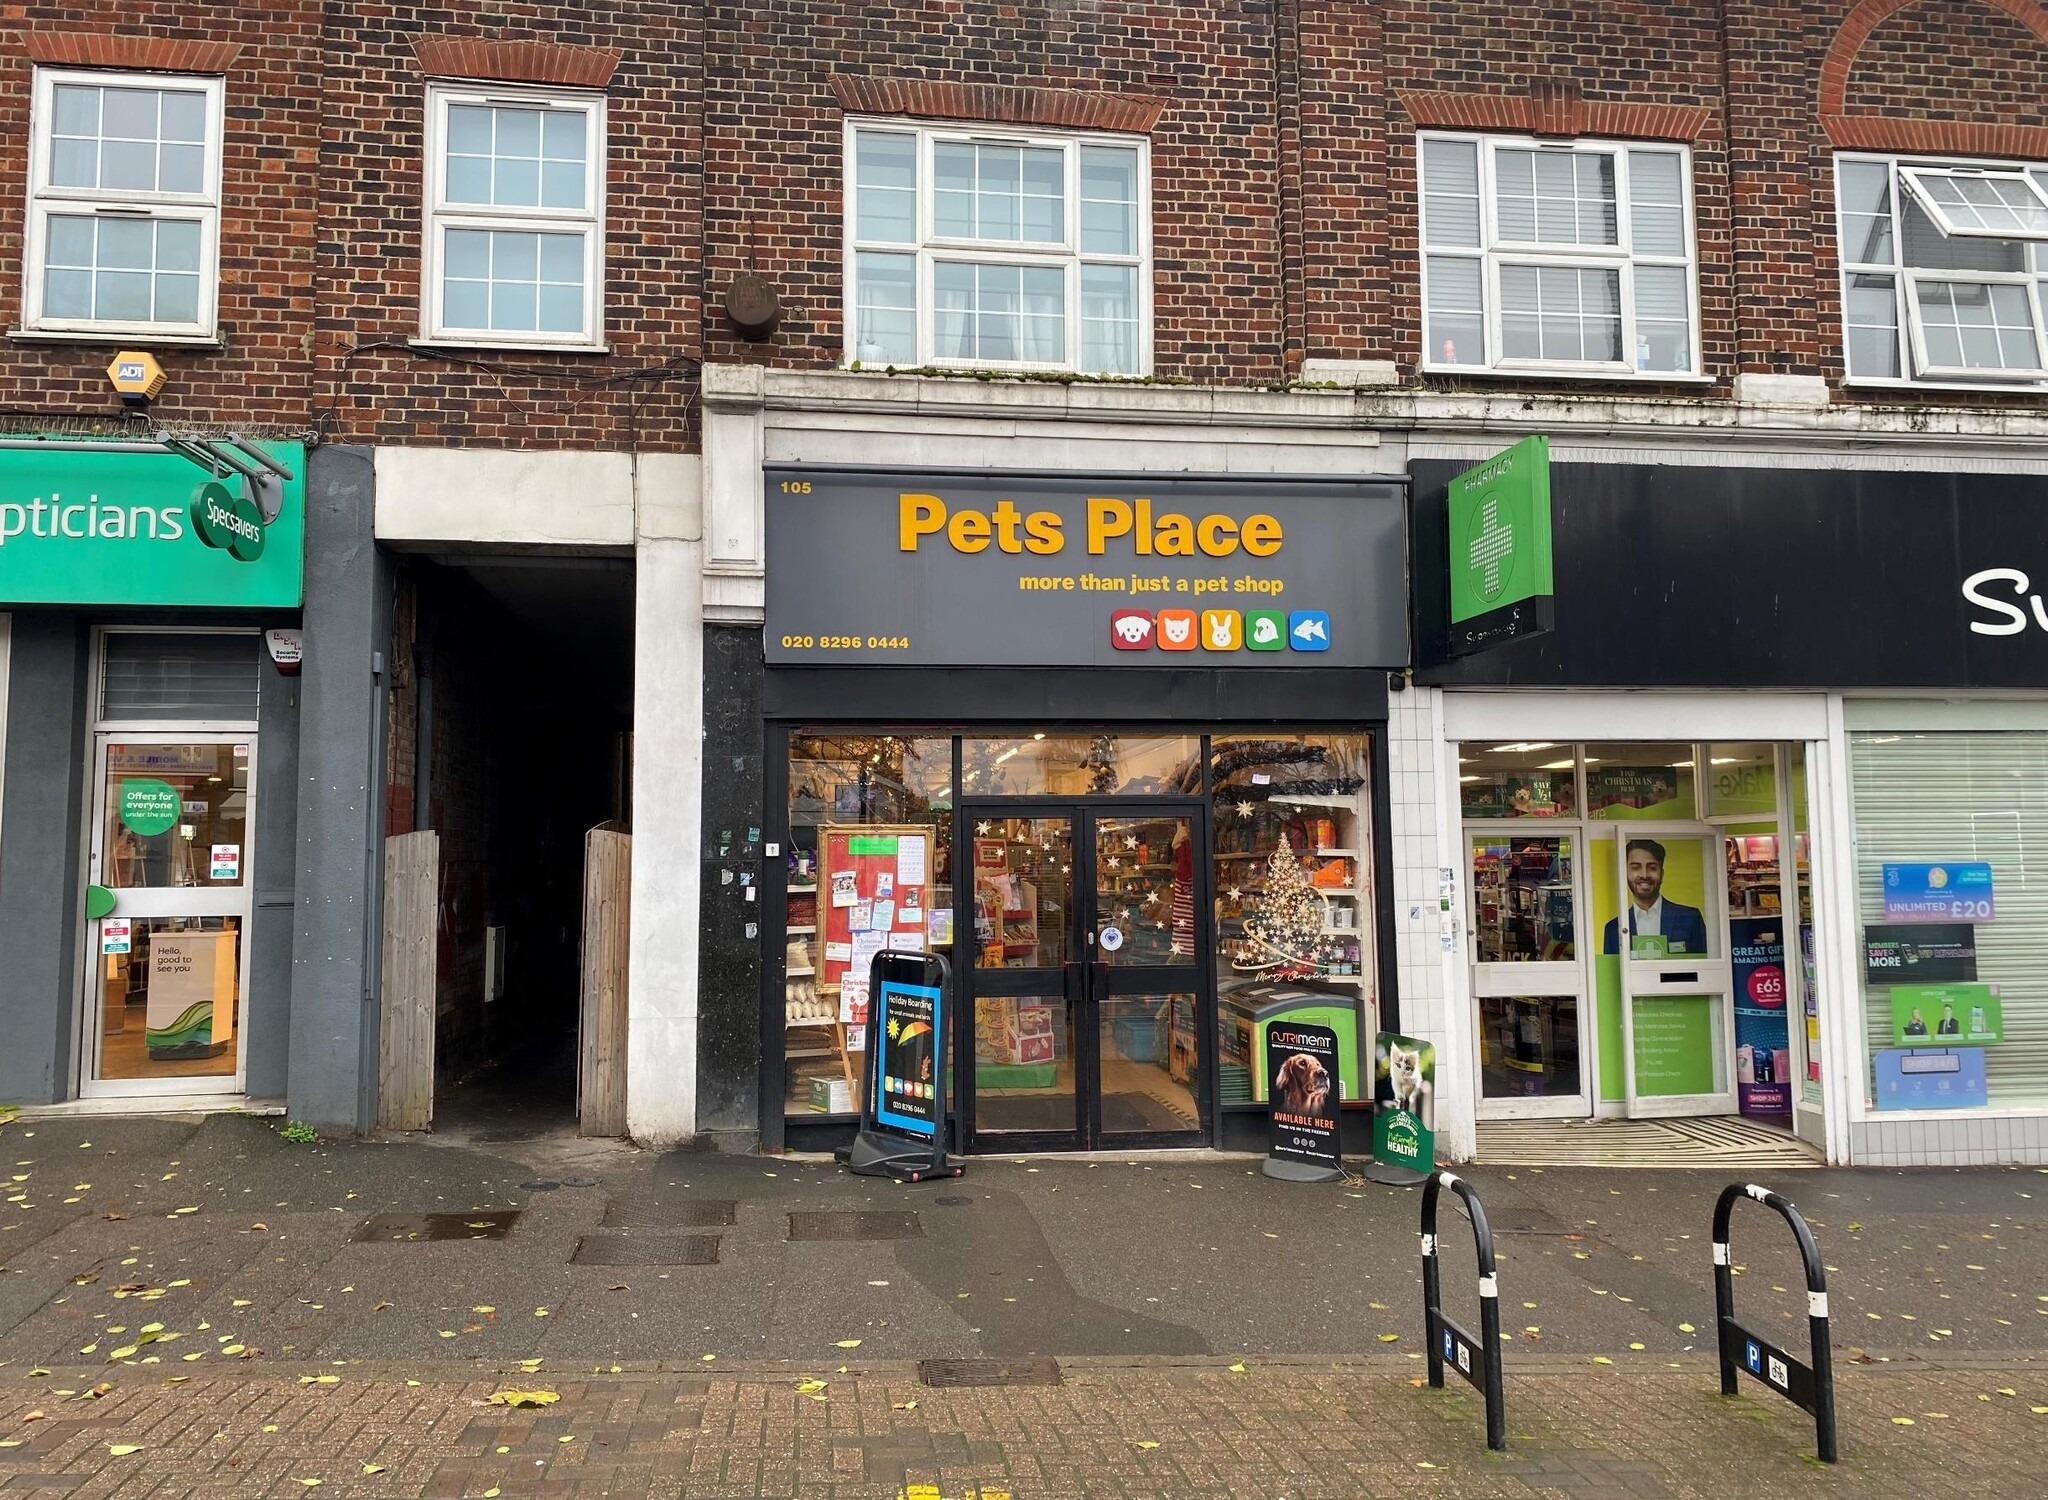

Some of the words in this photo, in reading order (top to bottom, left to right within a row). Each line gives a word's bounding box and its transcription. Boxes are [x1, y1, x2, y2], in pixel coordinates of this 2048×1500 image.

[119, 366, 145, 378] ADT
[1464, 455, 1515, 494] PHARMACY
[780, 481, 812, 494] 105
[207, 497, 260, 544] Specsavers
[899, 493, 1064, 556] Pets
[1086, 498, 1284, 558] Place
[1019, 576, 1075, 590] more
[1079, 573, 1125, 591] than
[1129, 574, 1170, 595] just
[1175, 578, 1188, 592] a
[1194, 576, 1228, 596] pet
[1233, 575, 1284, 596] shop
[781, 635, 814, 648] 020
[819, 636, 862, 649] 8296
[867, 636, 909, 649] 0444
[1604, 776, 1653, 787] CHRISTMAS
[127, 791, 157, 801] Offers
[159, 791, 174, 801] for
[126, 801, 173, 811] everyone
[1889, 902, 1947, 911] UNLIMITED
[1951, 900, 1991, 918] £20
[158, 947, 182, 955] Hello,
[1732, 946, 1766, 957] GREAT
[1869, 949, 1889, 957] SAVE
[157, 956, 181, 966] good
[182, 956, 193, 964] to
[1733, 956, 1769, 964] AMAZING
[1869, 957, 1901, 967] MORE
[174, 966, 191, 974] you
[1255, 971, 1284, 983] Merry
[1756, 978, 1781, 994] £65
[888, 994, 908, 1008] Holiday
[908, 997, 933, 1012] Boarding
[893, 1101, 901, 1109] 020
[901, 1103, 914, 1112] 8296
[913, 1106, 926, 1114] 0444
[1274, 1111, 1313, 1126] AVAILABLE
[1314, 1117, 1335, 1130] HERE
[1387, 1141, 1419, 1158] HEALTHY
[1749, 1345, 1758, 1367] P
